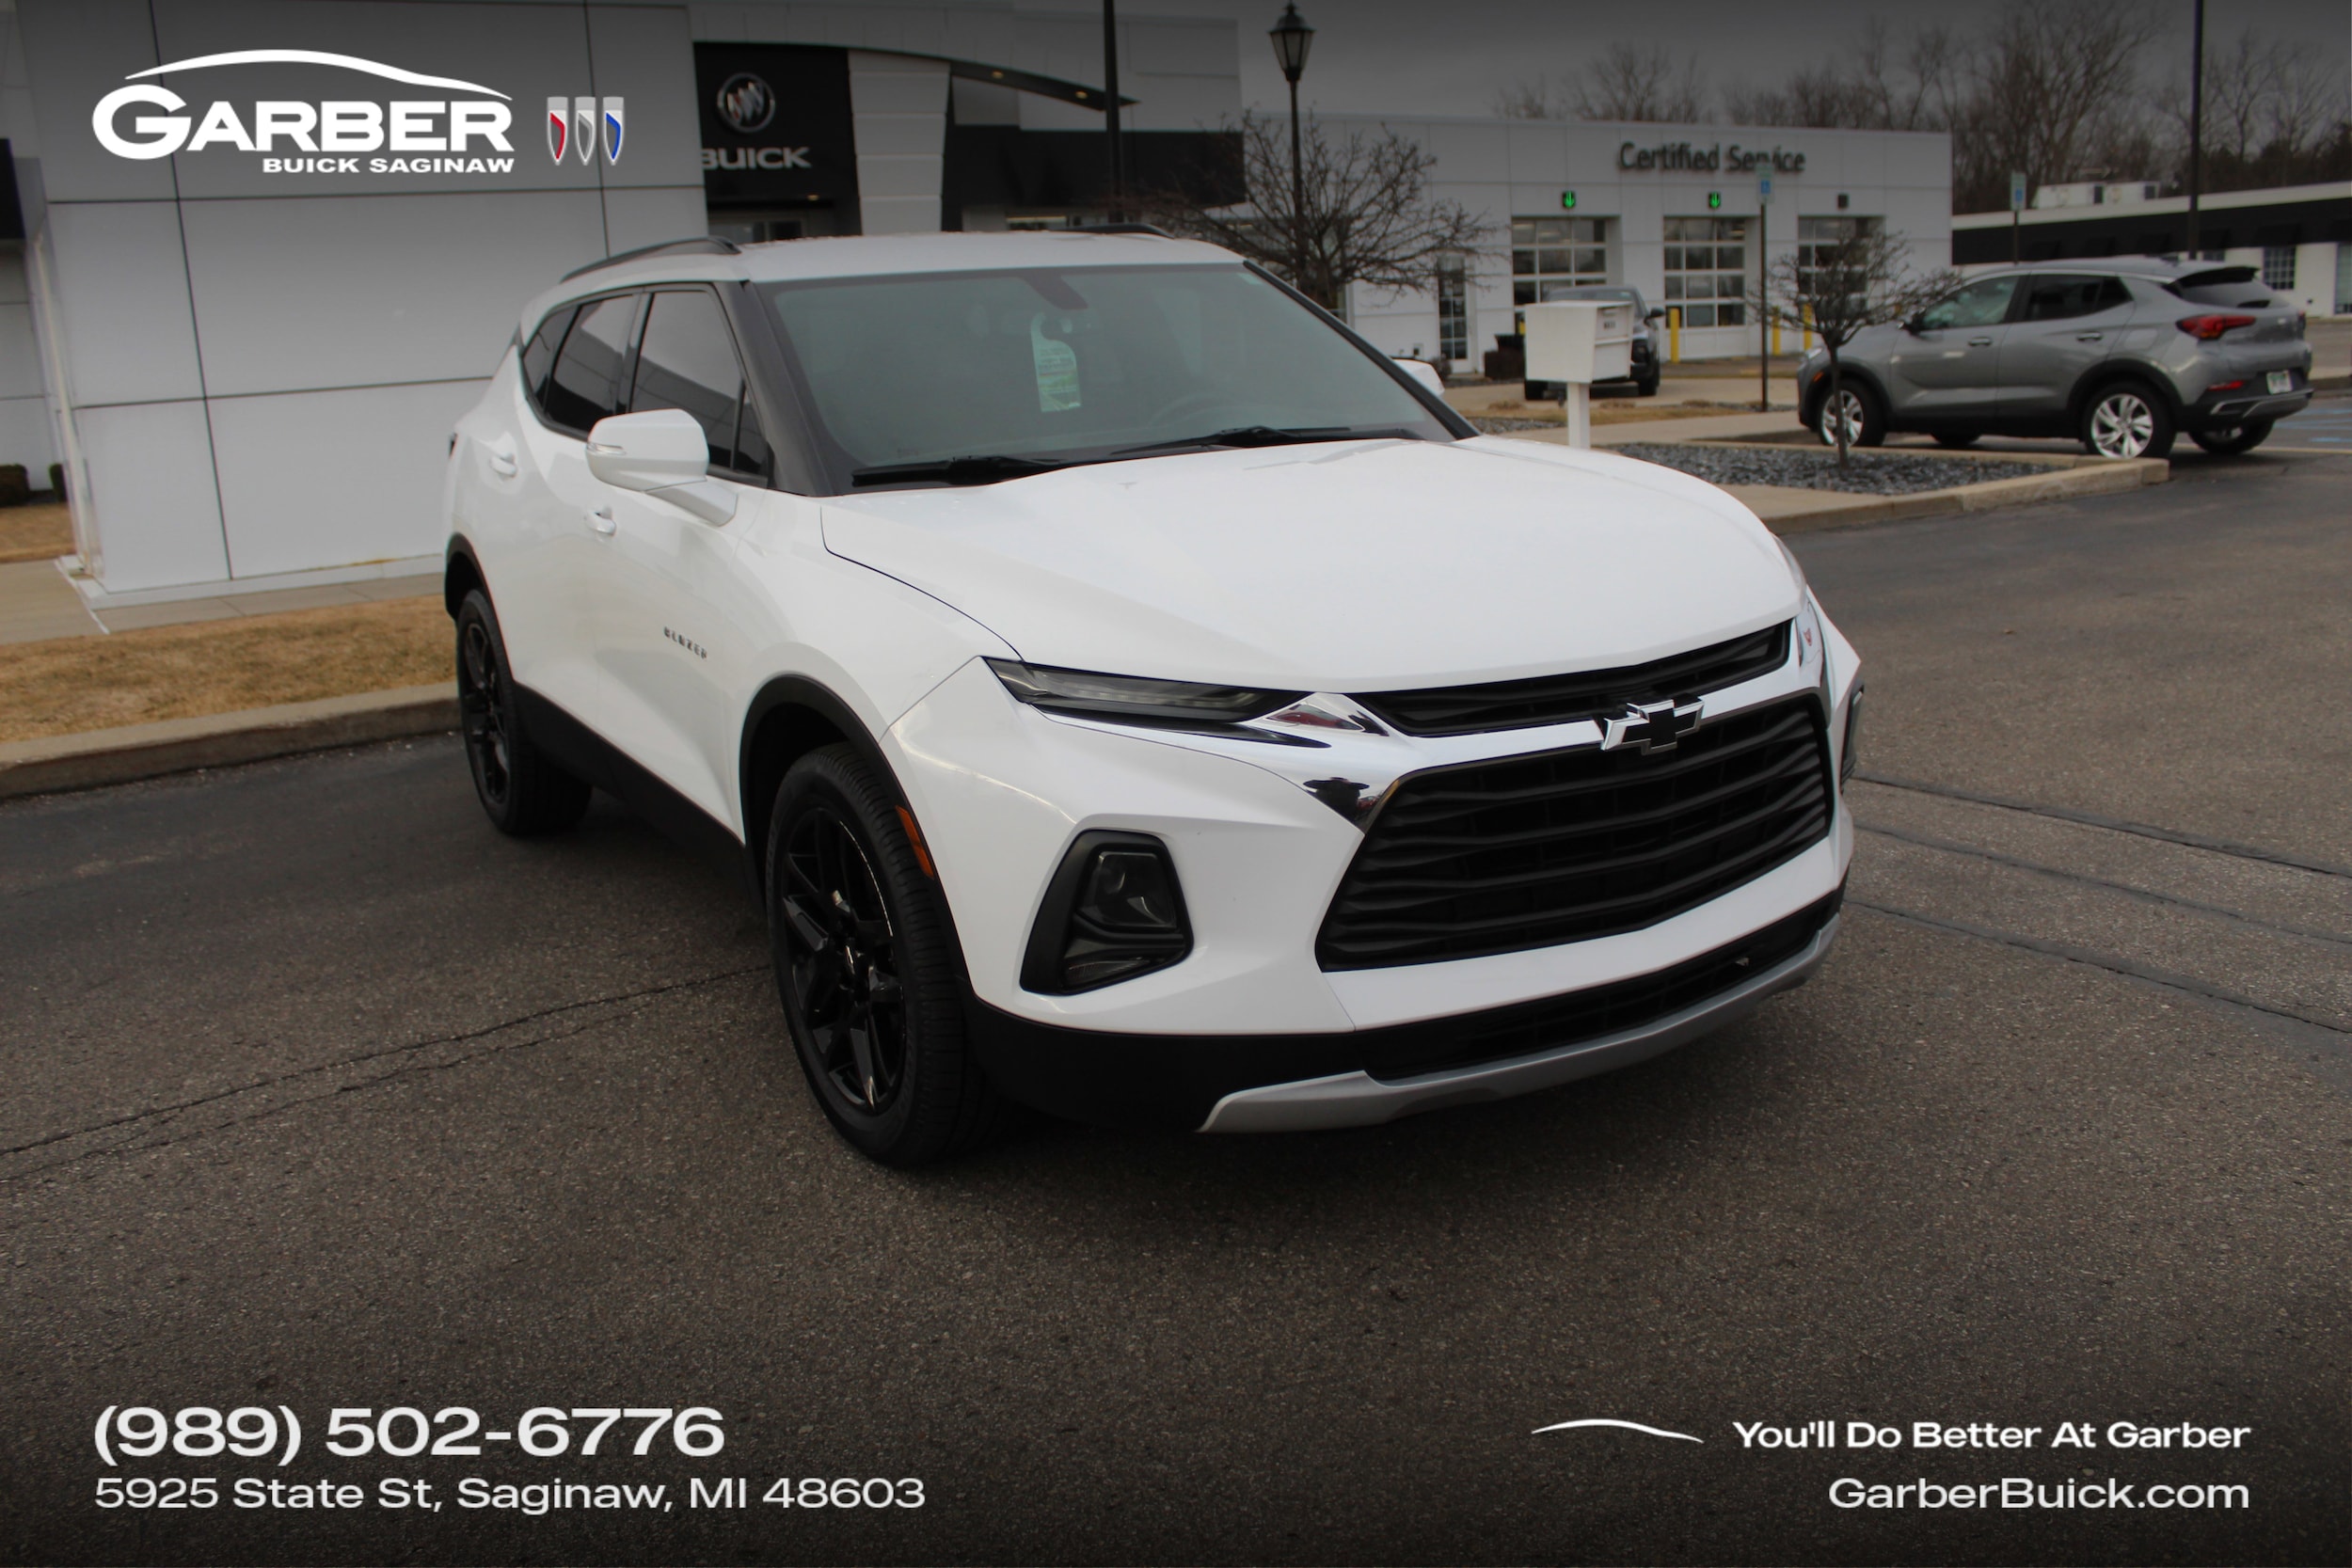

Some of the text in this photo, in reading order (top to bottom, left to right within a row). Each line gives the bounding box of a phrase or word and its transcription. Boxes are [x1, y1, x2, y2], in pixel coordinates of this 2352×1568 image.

[702, 147, 813, 170] BUICK
[1619, 141, 1721, 171] Certified
[663, 626, 707, 660] BLAZER
